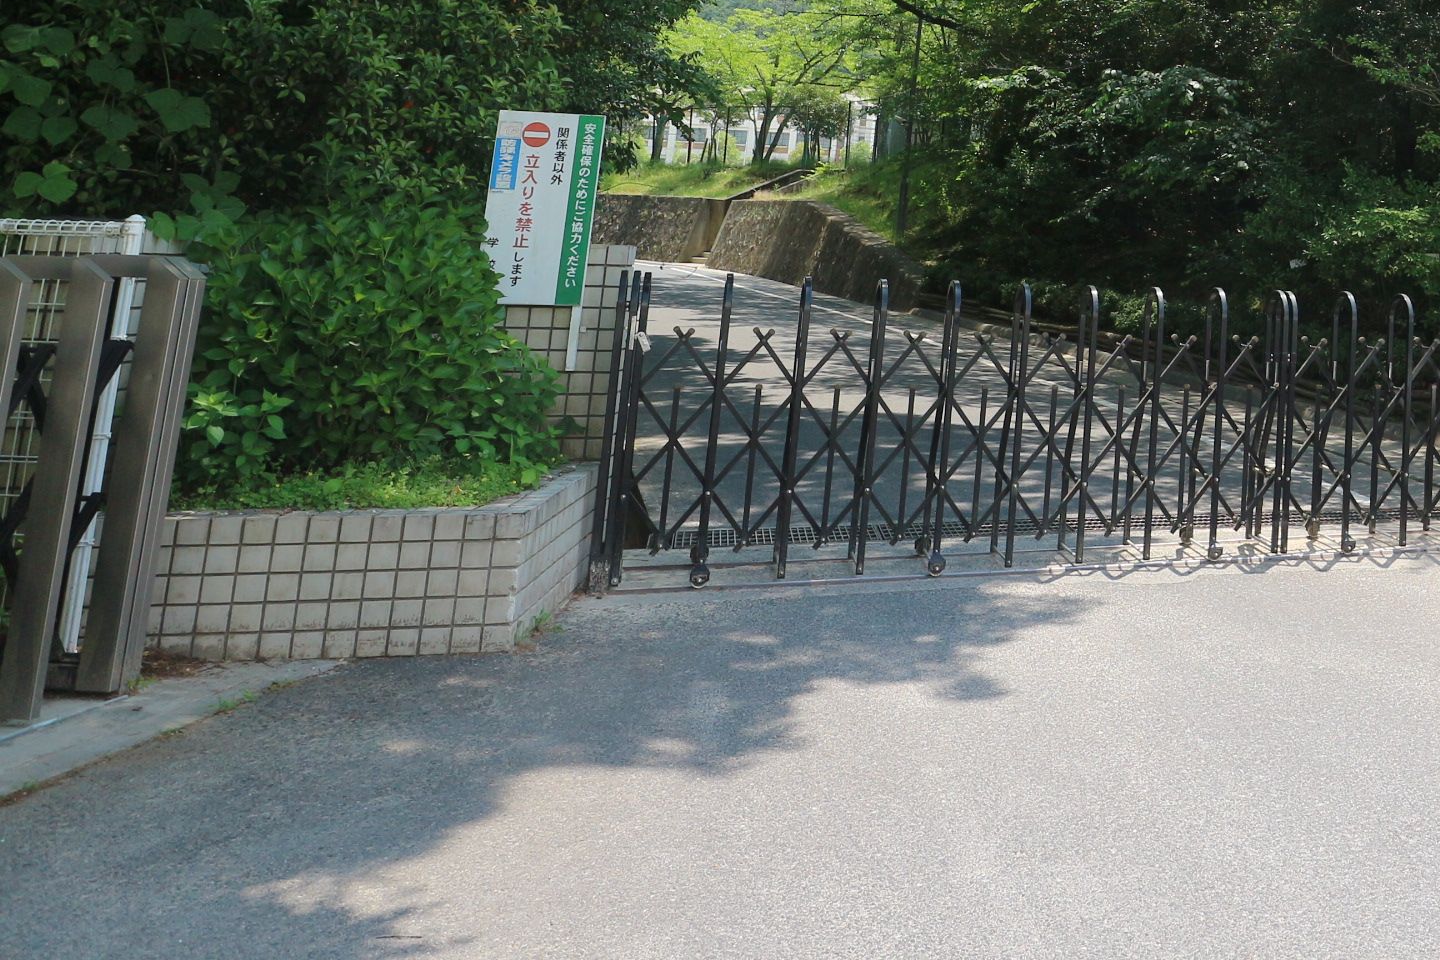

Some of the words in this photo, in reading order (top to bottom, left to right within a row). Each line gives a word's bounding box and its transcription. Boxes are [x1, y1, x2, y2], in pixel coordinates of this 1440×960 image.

[510, 154, 540, 286] 立入りを禁止します
[550, 127, 570, 186] 関係者以外
[565, 123, 596, 288] 安全確保のためにご協力ください
